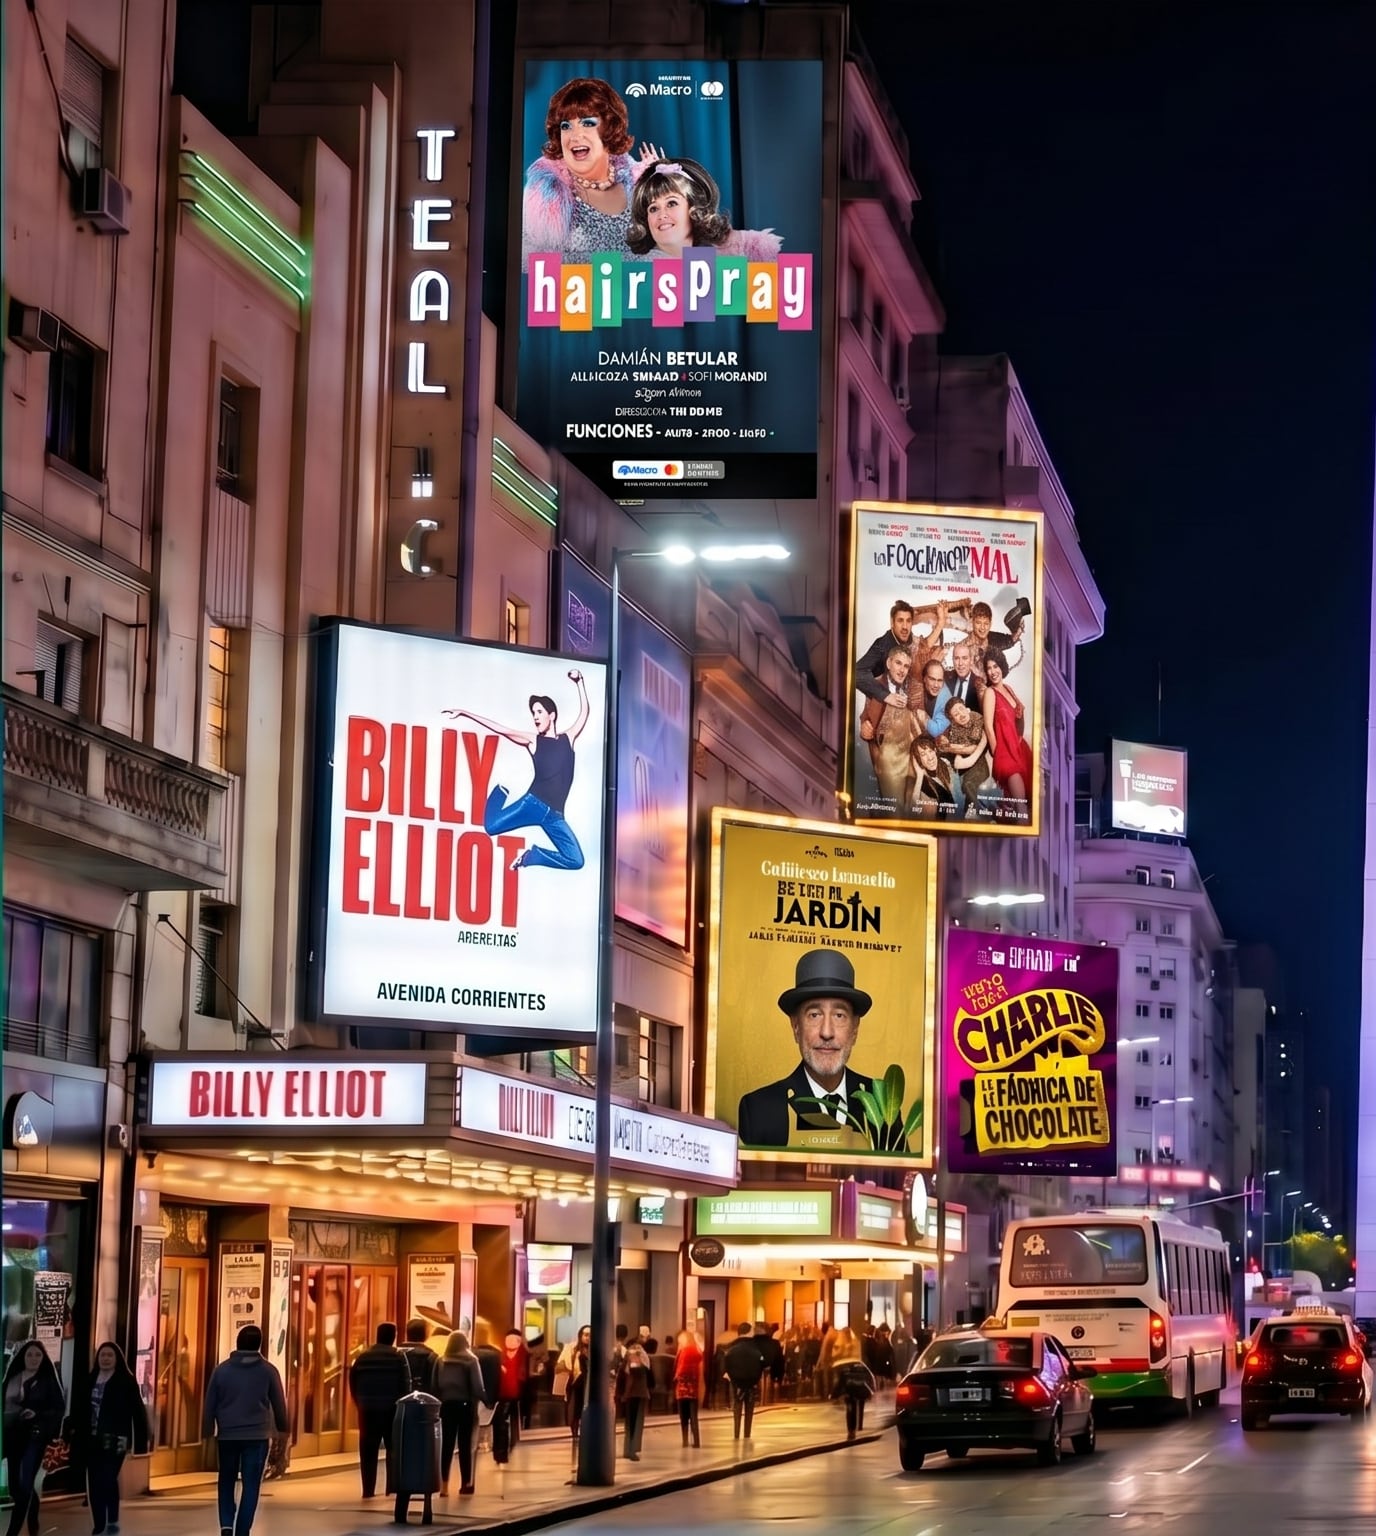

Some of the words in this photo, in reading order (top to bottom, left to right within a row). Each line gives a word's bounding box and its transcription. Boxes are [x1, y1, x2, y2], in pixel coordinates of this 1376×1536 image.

[649, 83, 692, 96] Macro
[532, 258, 807, 320] hairspray
[598, 347, 661, 366] DAMIÁN
[666, 351, 739, 366] BETULAR
[688, 371, 713, 382] SOFI
[714, 371, 768, 382] MORANDI
[566, 423, 654, 439] FUNCIONES
[970, 545, 1020, 584] MAL
[345, 715, 500, 825] BILLY
[341, 816, 527, 928] ELLIOT
[377, 982, 447, 1005] AVENIDA
[450, 987, 546, 1012] CORRIENTES
[957, 991, 1097, 1064] CHARLIE
[188, 1071, 275, 1118] BILLY
[283, 1069, 387, 1119] ELLIOT
[1075, 1075, 1097, 1103] DE
[984, 1104, 1102, 1146] CHOCOLATE
